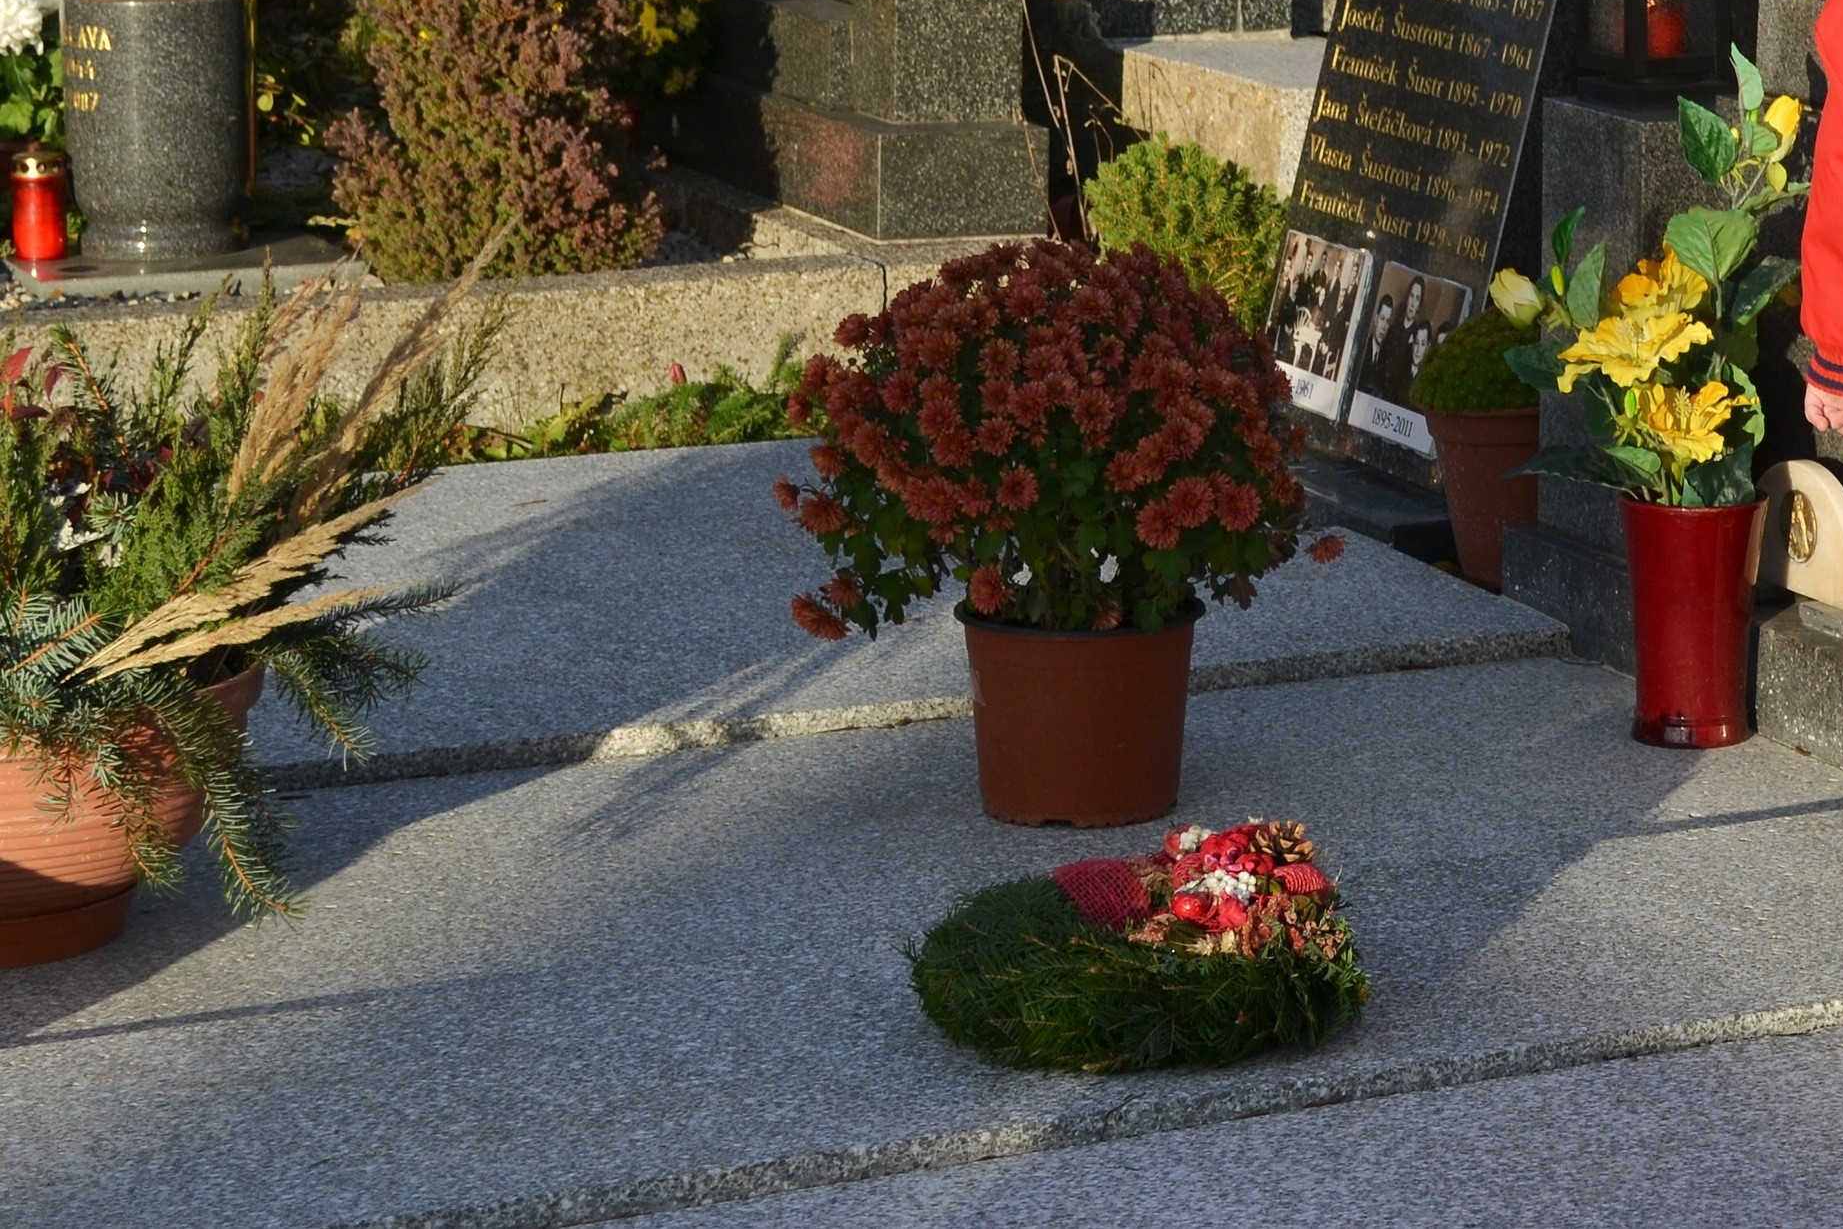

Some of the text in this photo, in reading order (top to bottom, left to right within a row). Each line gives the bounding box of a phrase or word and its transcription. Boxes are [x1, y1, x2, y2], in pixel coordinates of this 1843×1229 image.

[1391, 3, 1454, 50] Šustrová
[1459, 32, 1491, 59] 1867
[1501, 42, 1533, 70] 1961
[1331, 45, 1399, 87] František
[1405, 57, 1444, 98] Šustr
[1447, 79, 1478, 108] 1895
[1489, 92, 1522, 119] 1970
[1313, 87, 1348, 122] Jana
[1355, 92, 1433, 146] Štefáčková
[1436, 127, 1467, 154] 1893
[1478, 139, 1511, 167] 1972
[1310, 134, 1352, 171] Vlasta
[1359, 142, 1422, 192] Šustrová
[1425, 174, 1455, 202] 1896
[1468, 188, 1500, 215] 1974
[1299, 179, 1366, 224] František
[1373, 195, 1412, 237] Šustr
[1415, 220, 1446, 247] 1929
[1456, 234, 1488, 262] 1984
[1371, 407, 1413, 438] 1895-2011
